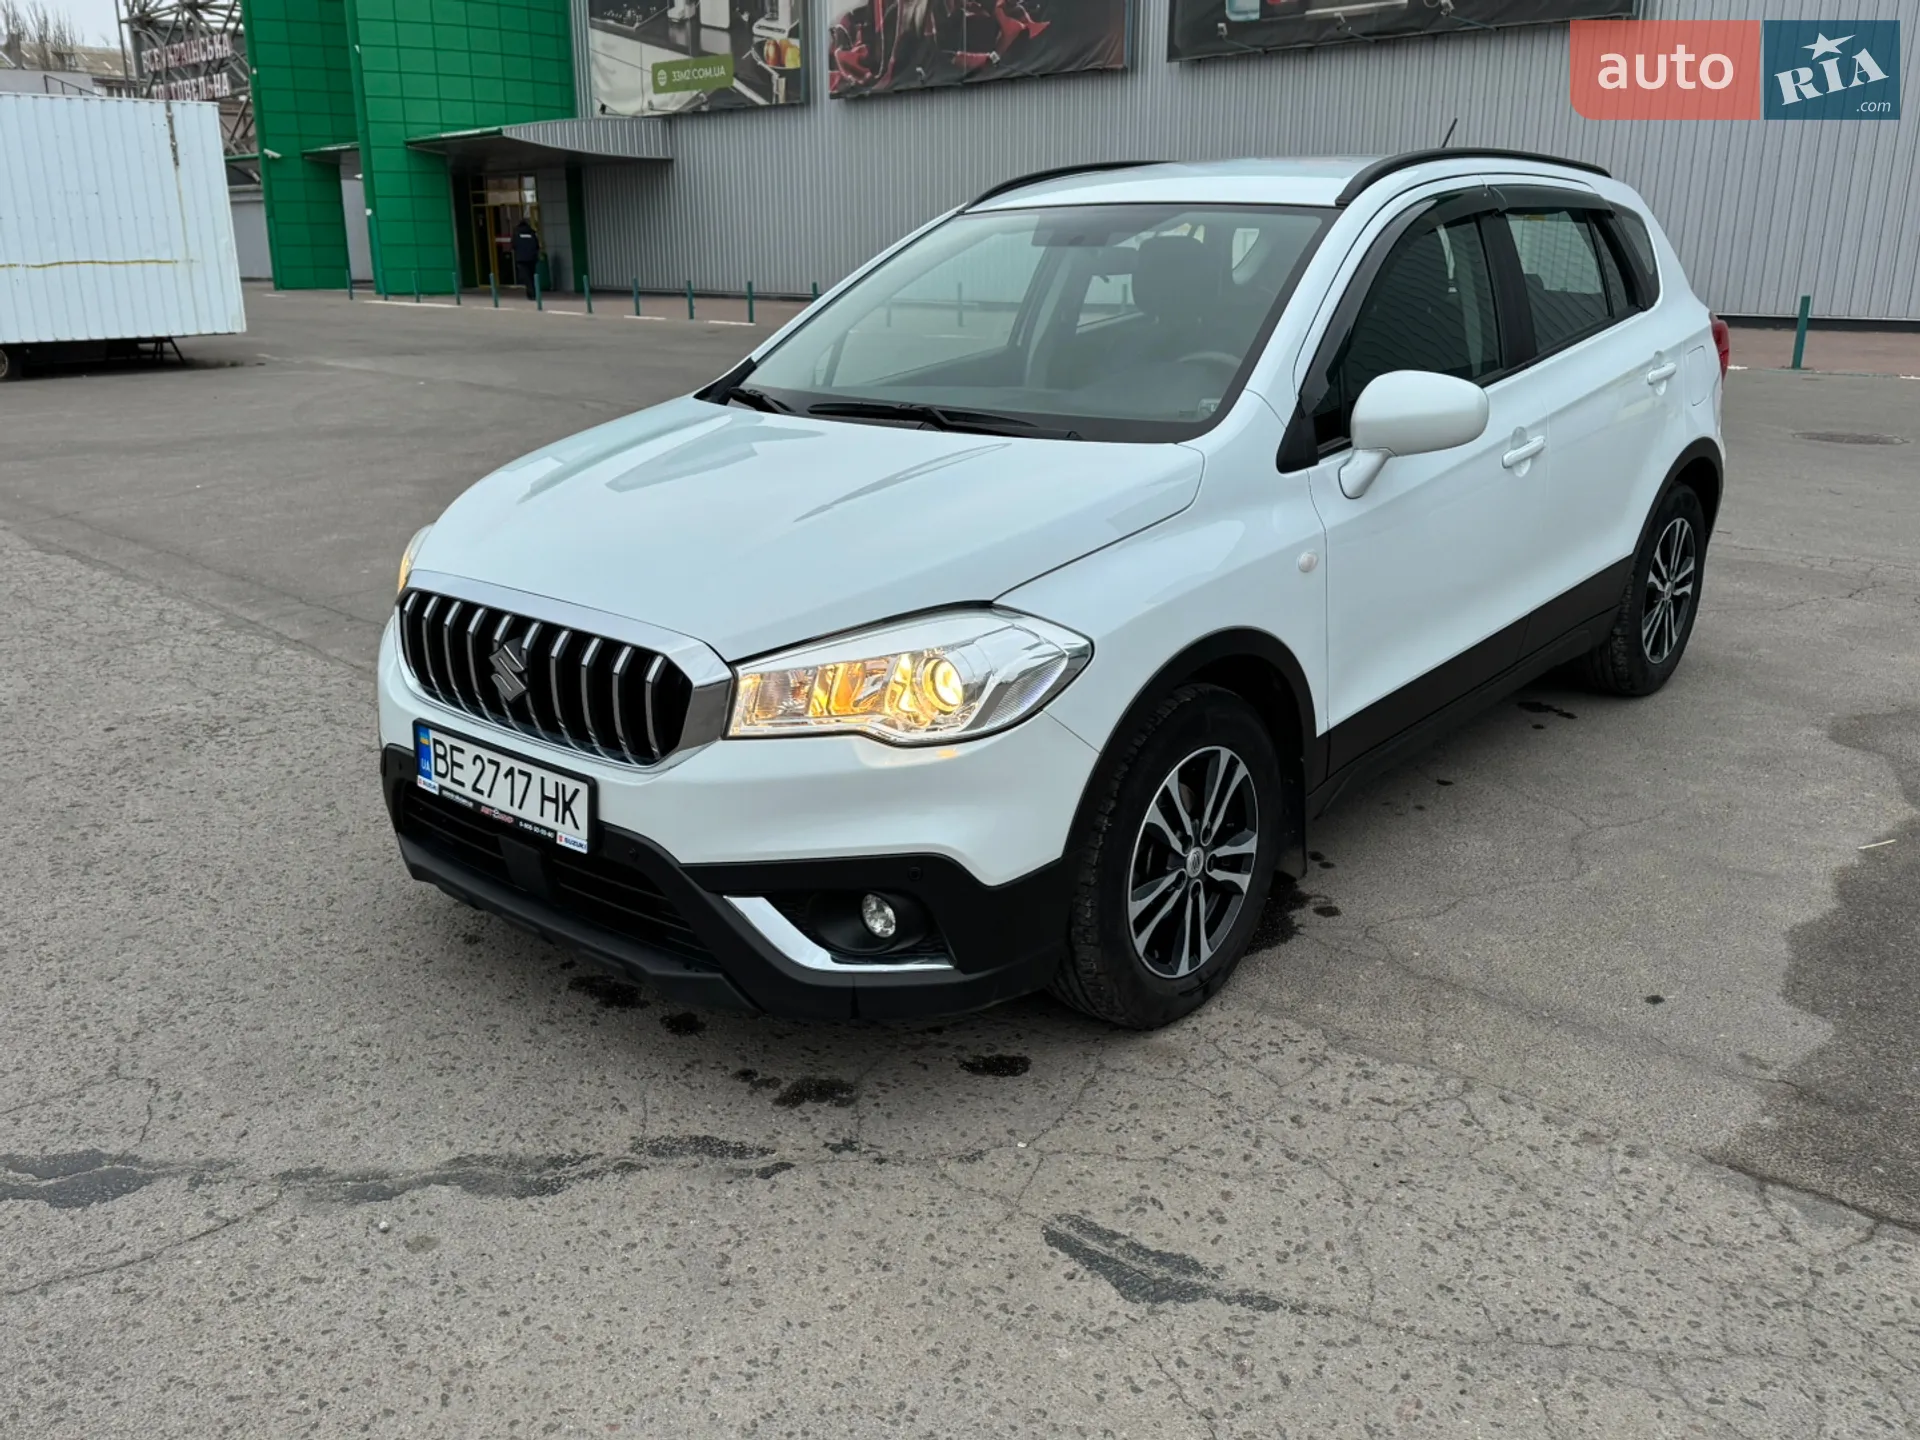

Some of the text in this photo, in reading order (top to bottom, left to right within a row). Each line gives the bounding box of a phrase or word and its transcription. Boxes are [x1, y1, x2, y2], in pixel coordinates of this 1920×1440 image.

[151, 72, 230, 100] ТОГОВЕЛЬНА
[421, 757, 431, 772] UA
[432, 738, 580, 831] BE 2717 HK
[564, 837, 587, 851] SUZUKI
